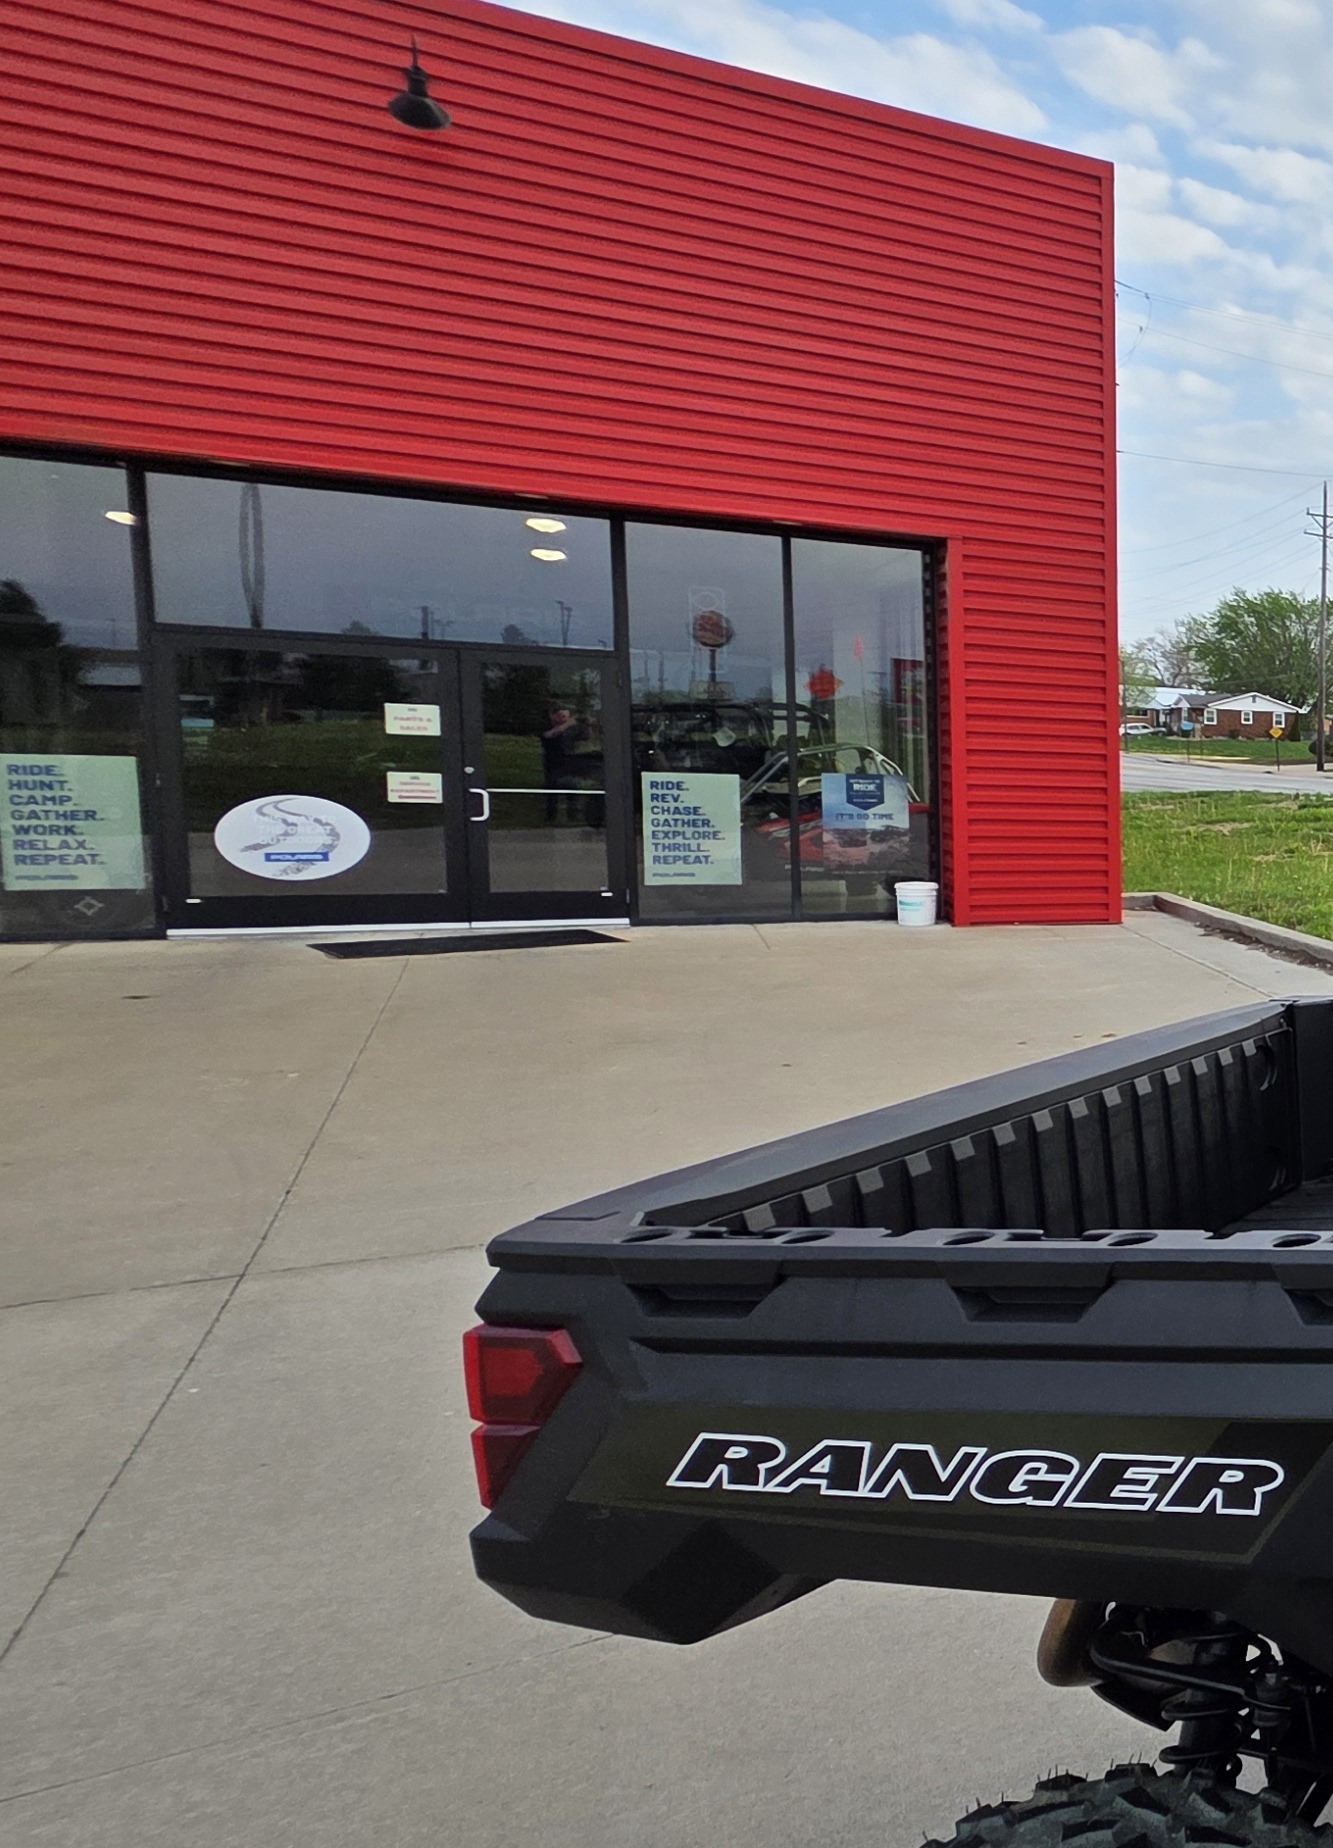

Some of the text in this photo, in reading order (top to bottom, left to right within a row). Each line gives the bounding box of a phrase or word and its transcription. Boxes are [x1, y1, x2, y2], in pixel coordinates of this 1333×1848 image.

[6, 764, 65, 776] RIDE.
[8, 779, 74, 791] HUNT.
[650, 780, 690, 791] RIDE.
[9, 794, 80, 806] CAMP.
[650, 793, 684, 803] REV.
[10, 809, 105, 821] GATHER.
[650, 806, 706, 816] CHASE.
[651, 818, 715, 828] GATHER.
[12, 824, 84, 836] WORK.
[651, 830, 725, 840] EXPLORE.
[13, 839, 95, 851] RELAX.
[14, 853, 106, 866] REPEAT.
[652, 855, 715, 865] REPEAT.
[665, 1431, 1284, 1517] RANGER
